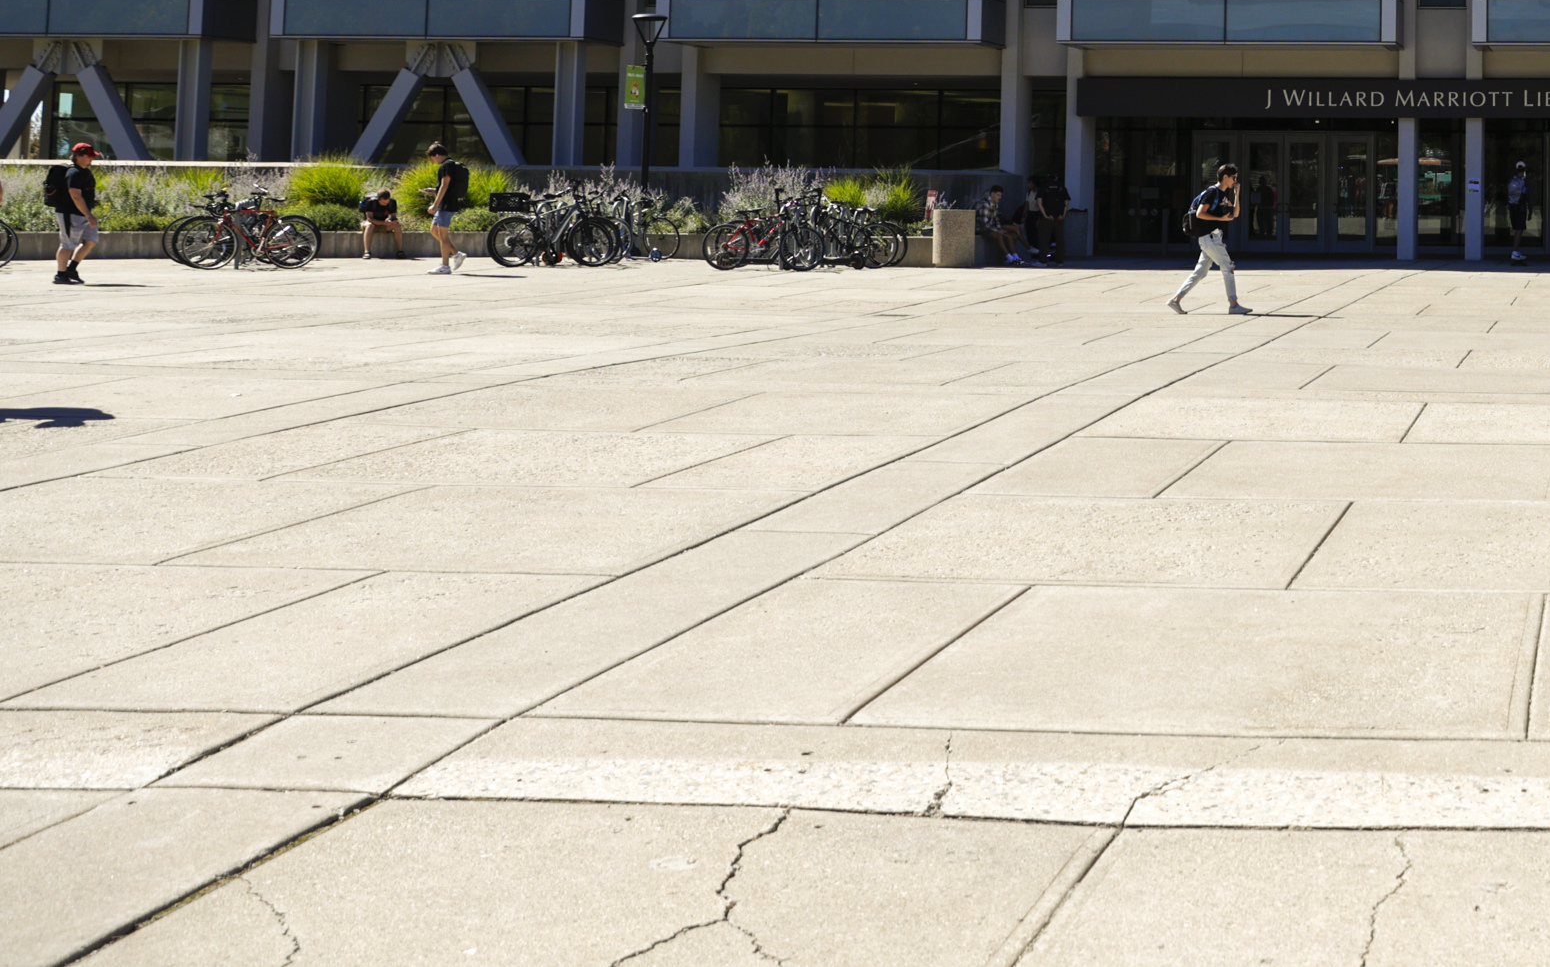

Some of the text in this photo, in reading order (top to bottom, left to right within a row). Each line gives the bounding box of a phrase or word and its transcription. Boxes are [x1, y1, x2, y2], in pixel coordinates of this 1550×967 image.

[1265, 89, 1272, 109] J
[1283, 89, 1385, 107] WILLARD
[1395, 89, 1513, 107] MARRIOTT
